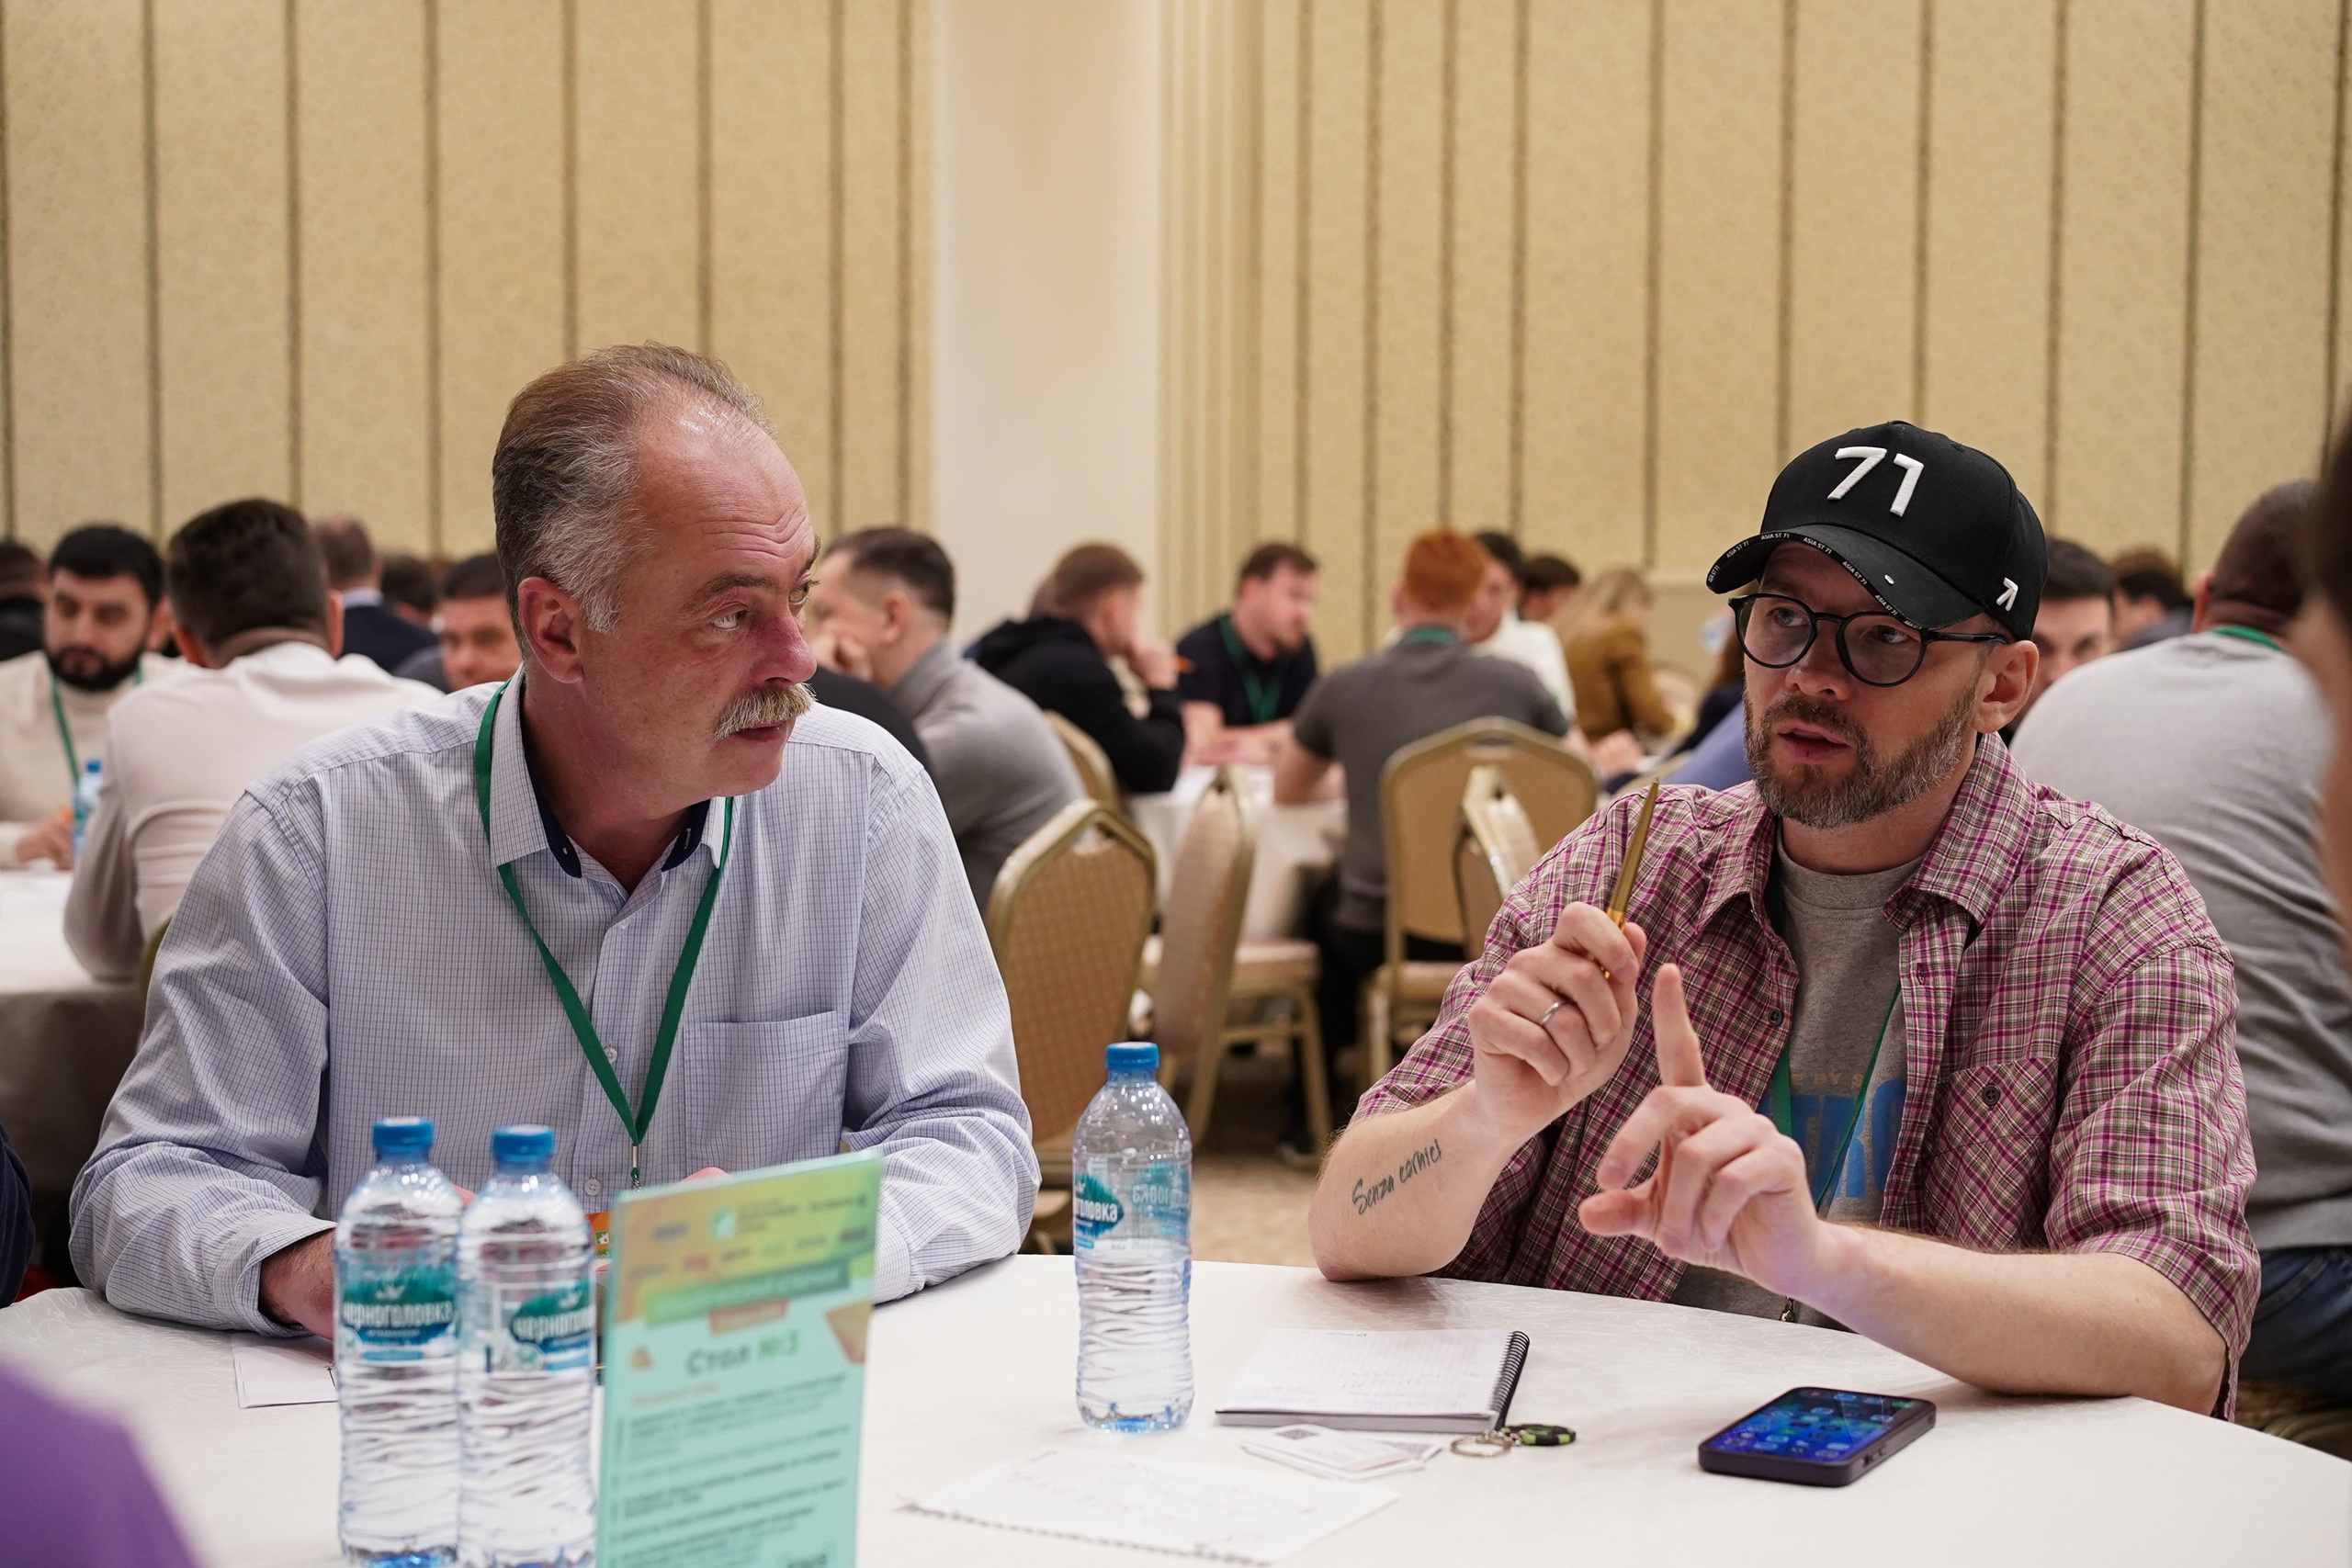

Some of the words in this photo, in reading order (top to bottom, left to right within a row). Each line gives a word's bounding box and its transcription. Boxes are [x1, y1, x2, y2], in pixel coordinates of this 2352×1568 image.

[1826, 446, 1925, 517] 71
[1760, 533, 1775, 541] ASIA
[1803, 536, 1817, 547] ASIA
[1726, 547, 1737, 558] ASIA
[1742, 540, 1749, 548] 71
[1842, 560, 1856, 574] ASIA
[1854, 570, 1862, 579] ST
[1860, 577, 1868, 585] 71
[1874, 594, 1887, 606] ASIA
[1885, 604, 1894, 613] ST
